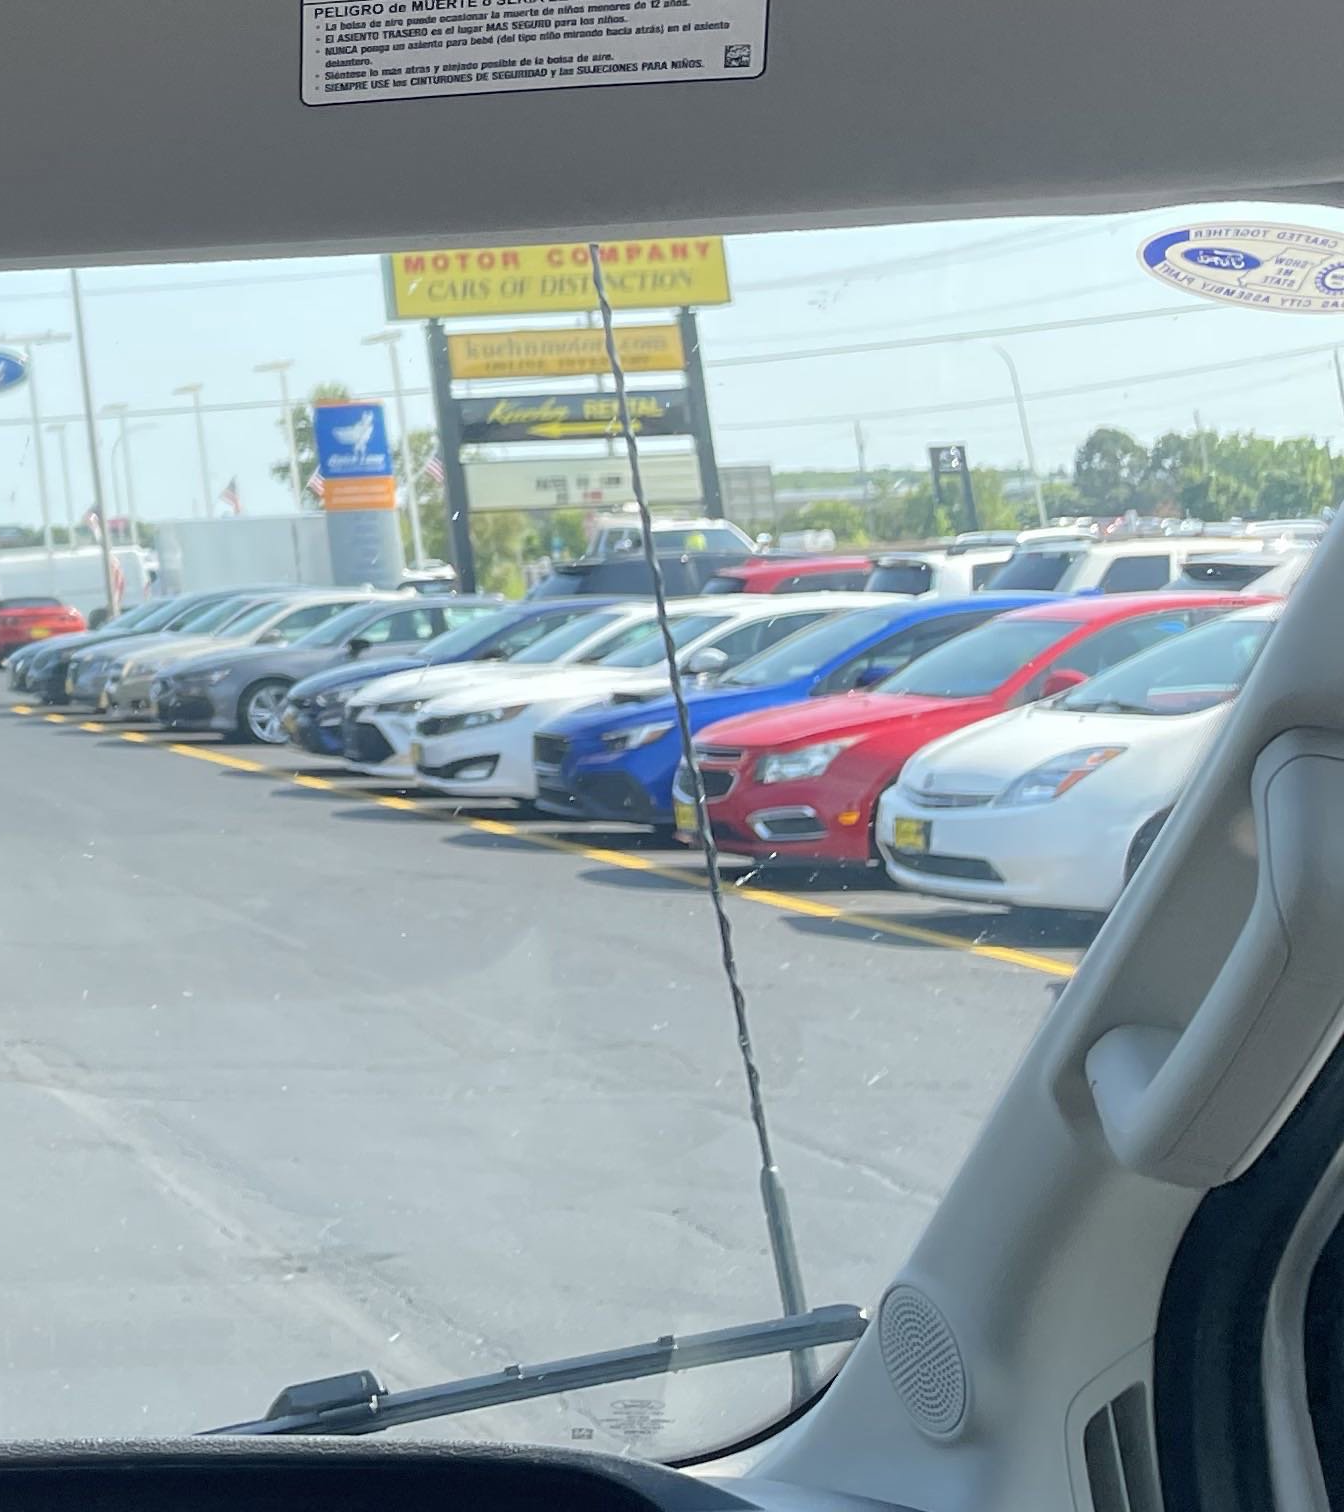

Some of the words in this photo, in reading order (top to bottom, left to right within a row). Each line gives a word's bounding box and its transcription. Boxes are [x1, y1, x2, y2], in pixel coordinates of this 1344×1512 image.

[313, 2, 384, 19] PELIGRO
[388, 1, 407, 13] de
[404, 250, 520, 274] MOTOR
[547, 241, 711, 266] COMPANY
[428, 278, 490, 302] CARS
[500, 277, 530, 298] OF
[541, 267, 693, 296] DISTNCTION
